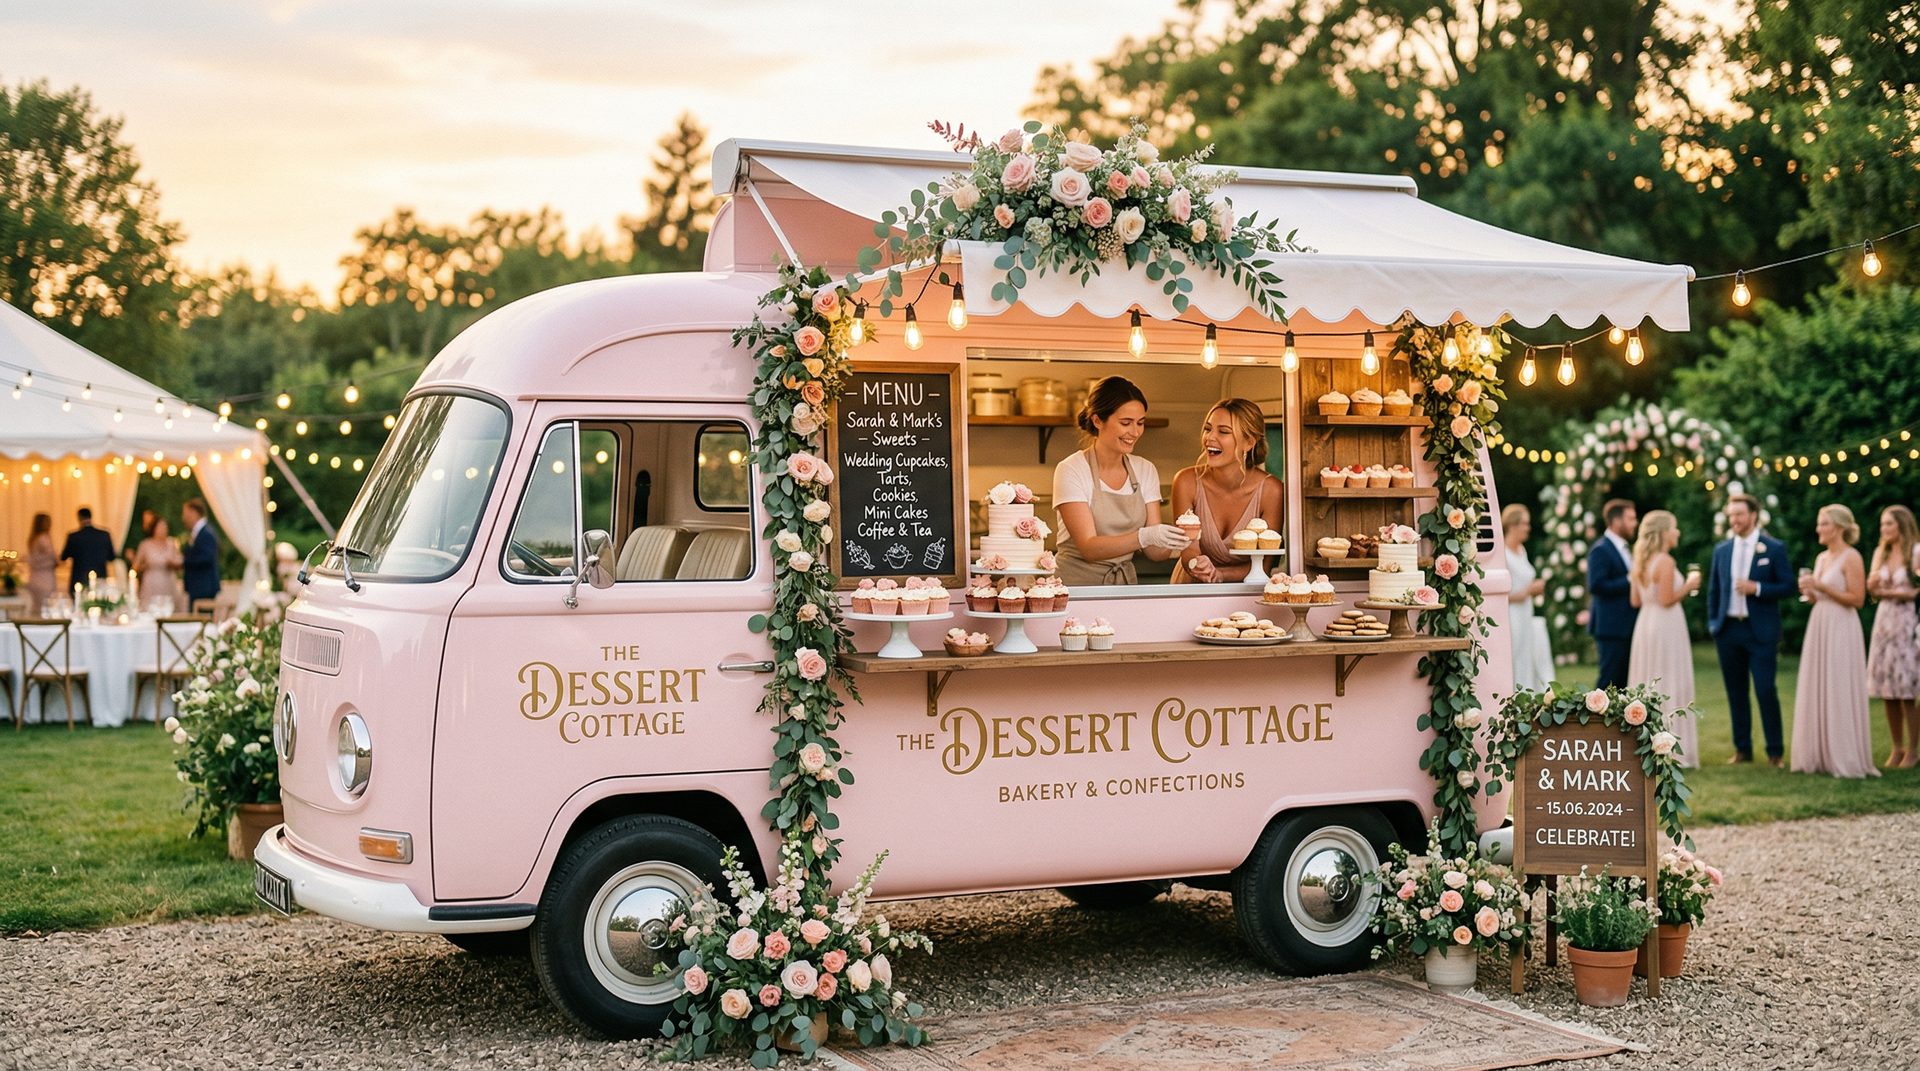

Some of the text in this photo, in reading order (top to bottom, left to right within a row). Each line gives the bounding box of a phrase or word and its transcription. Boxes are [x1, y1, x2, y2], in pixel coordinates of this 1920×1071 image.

[863, 382, 924, 406] MENU
[846, 411, 943, 429] Sarah & Mark's
[872, 431, 917, 447] Sweets
[845, 452, 949, 472] Wedding Cupcakes,
[877, 471, 912, 487] Tarts,
[873, 487, 919, 503] Cookies,
[864, 505, 928, 520] Mini Cakes
[857, 522, 933, 541] Coffee & Tea
[600, 645, 640, 661] THE
[517, 661, 706, 721] DESSERT
[559, 711, 685, 744] COTTAGE
[896, 697, 1334, 775] THE DESSERT COTTAGE
[1543, 739, 1622, 762] SARAH
[999, 772, 1246, 802] BAKERY & CONFECTIONS
[1538, 768, 1631, 792] & MARK
[1547, 801, 1623, 816] 15.06.2024
[1535, 828, 1635, 847] CELEBRATE!
